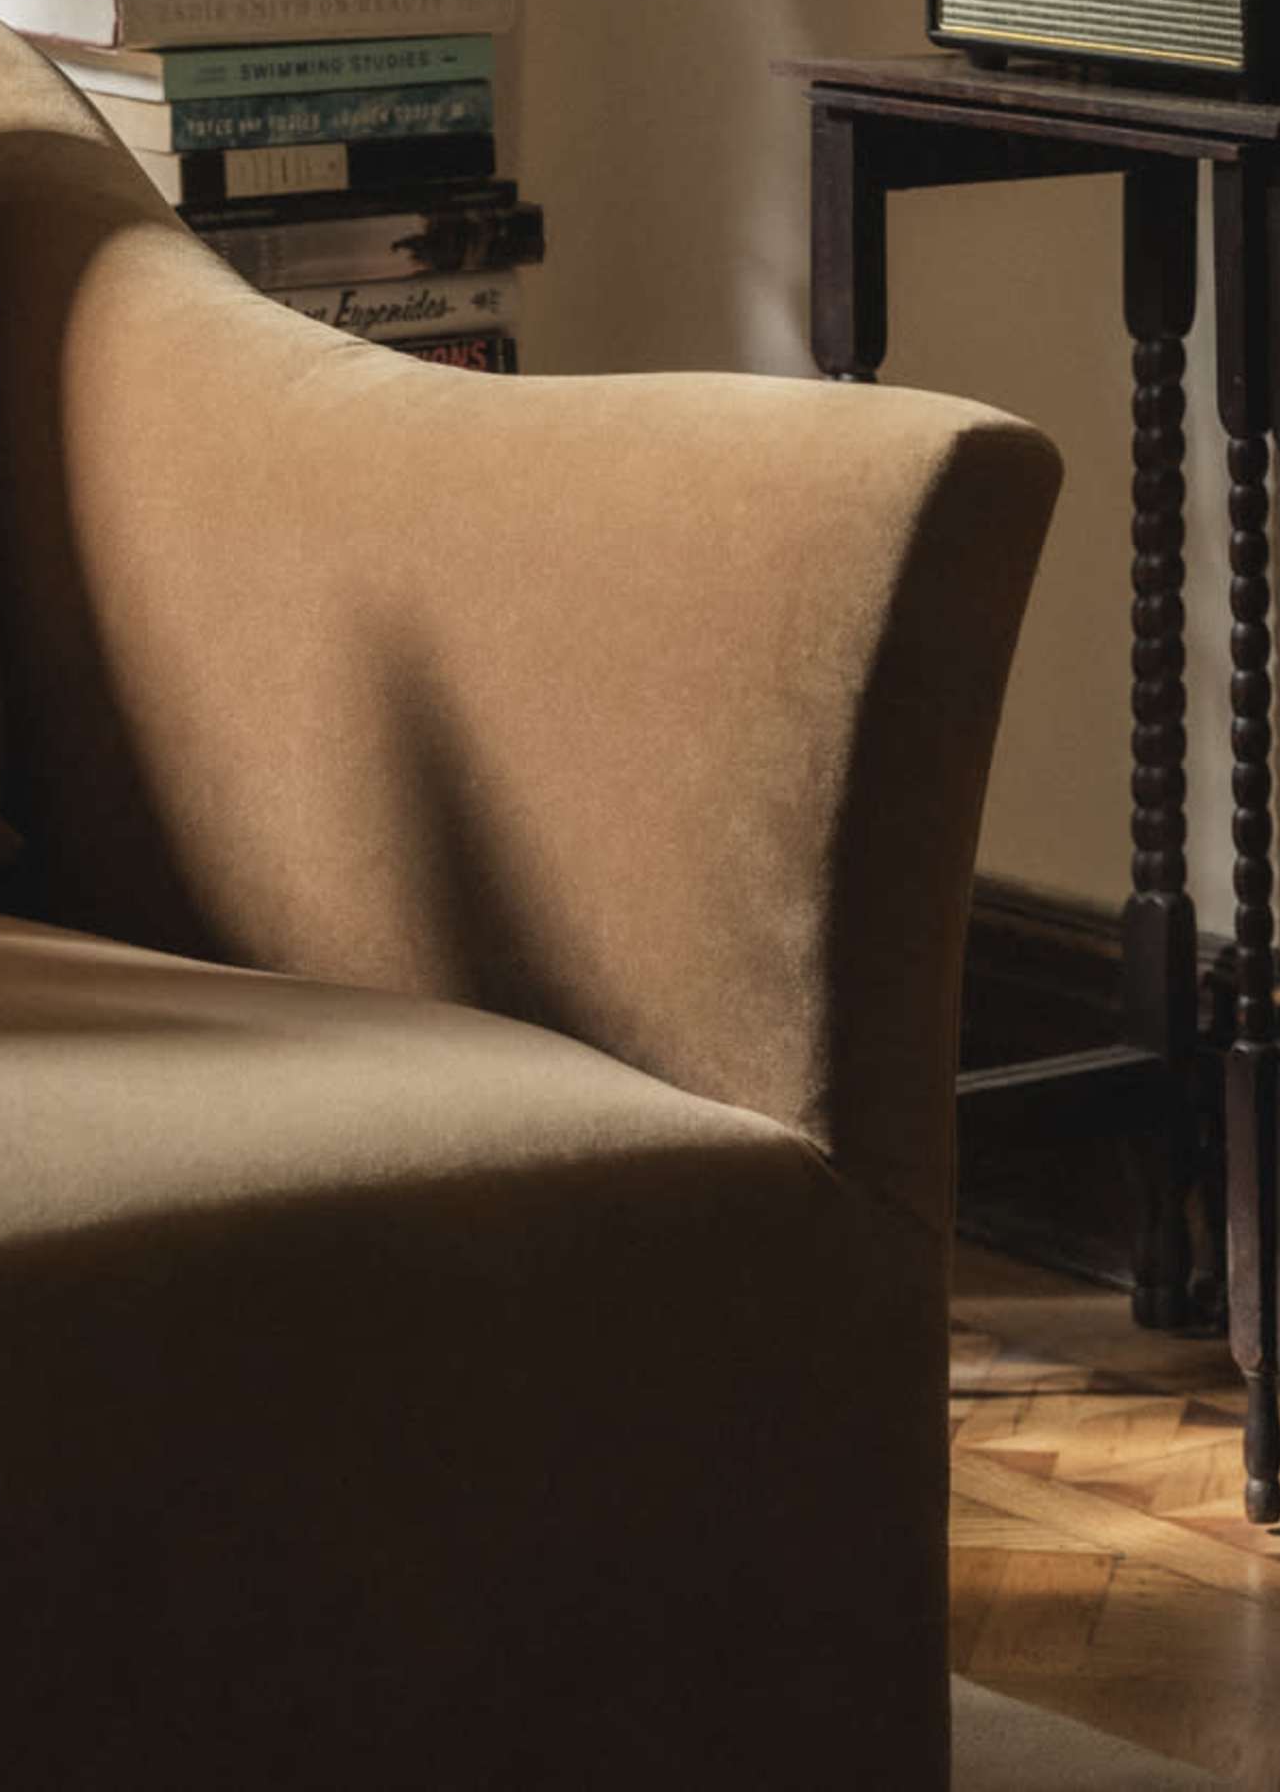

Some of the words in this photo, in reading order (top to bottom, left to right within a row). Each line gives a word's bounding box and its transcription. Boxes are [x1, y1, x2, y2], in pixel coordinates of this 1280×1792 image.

[239, 55, 344, 82] SWIMMING
[348, 50, 431, 75] STUDIES
[332, 289, 458, 328] Eugenides
